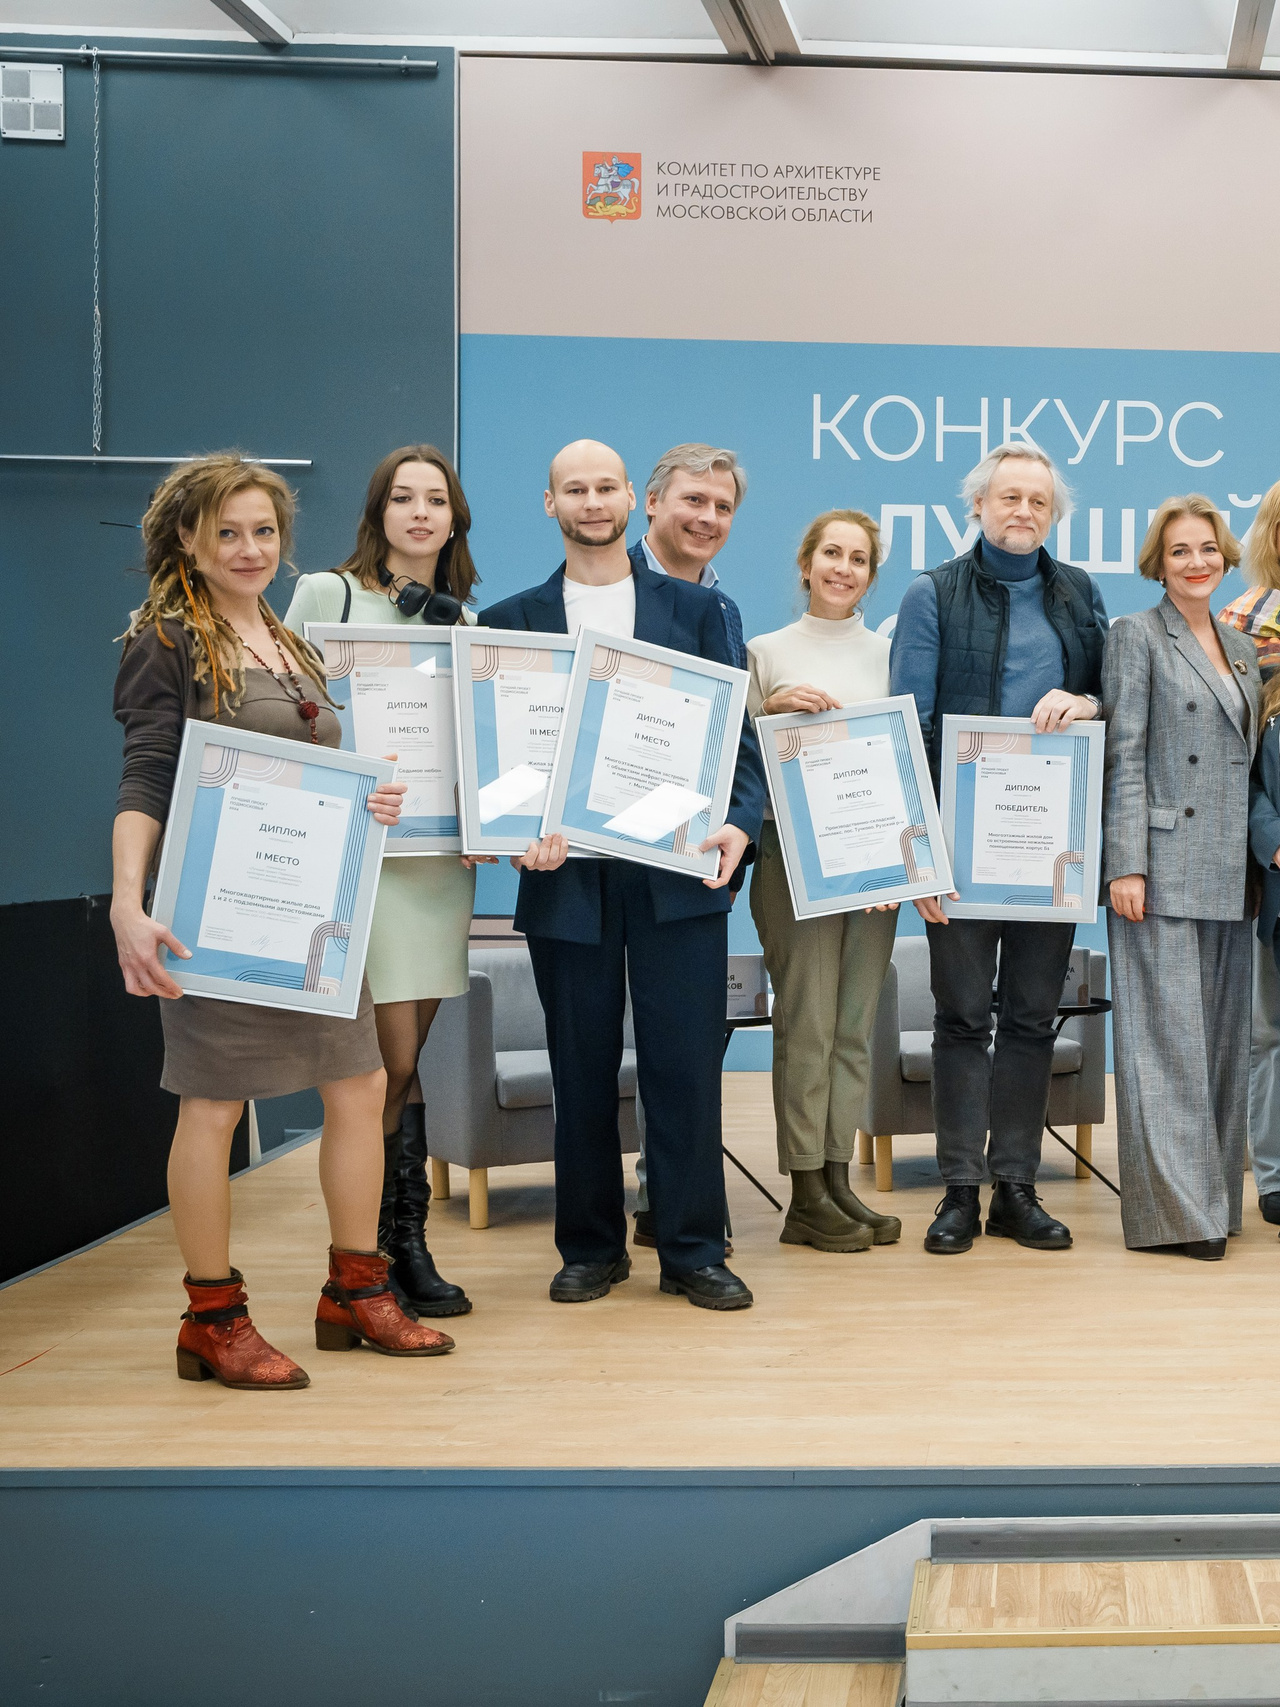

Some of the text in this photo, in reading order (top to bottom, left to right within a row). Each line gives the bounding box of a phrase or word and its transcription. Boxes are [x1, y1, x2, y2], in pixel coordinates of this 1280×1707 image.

[657, 162, 881, 181] КОМИТЕТ ПО АРХИТЕКТУРЕ
[657, 183, 868, 202] И ГРАДОСТРОИТЕЛЬСТВУ
[656, 204, 873, 223] МОСКОВСКОЙ ОБЛАСТИ
[812, 393, 1225, 468] КОНКУРС
[637, 713, 675, 728] ДИПЛОМ
[641, 734, 670, 747] МЕСТО
[833, 768, 868, 780] ДИПЛОМ
[846, 790, 872, 799] МЕСТО
[1005, 784, 1041, 792] ДИПЛОМ
[995, 804, 1048, 813] ПОБЕДИТЕЛЬ
[259, 824, 306, 838] ДИПЛОМ
[264, 853, 300, 866] МЕСТО
[220, 888, 279, 903] Многоквартирные
[281, 899, 303, 907] жилые
[234, 899, 275, 910] подземными
[276, 906, 325, 918] автостоянками
